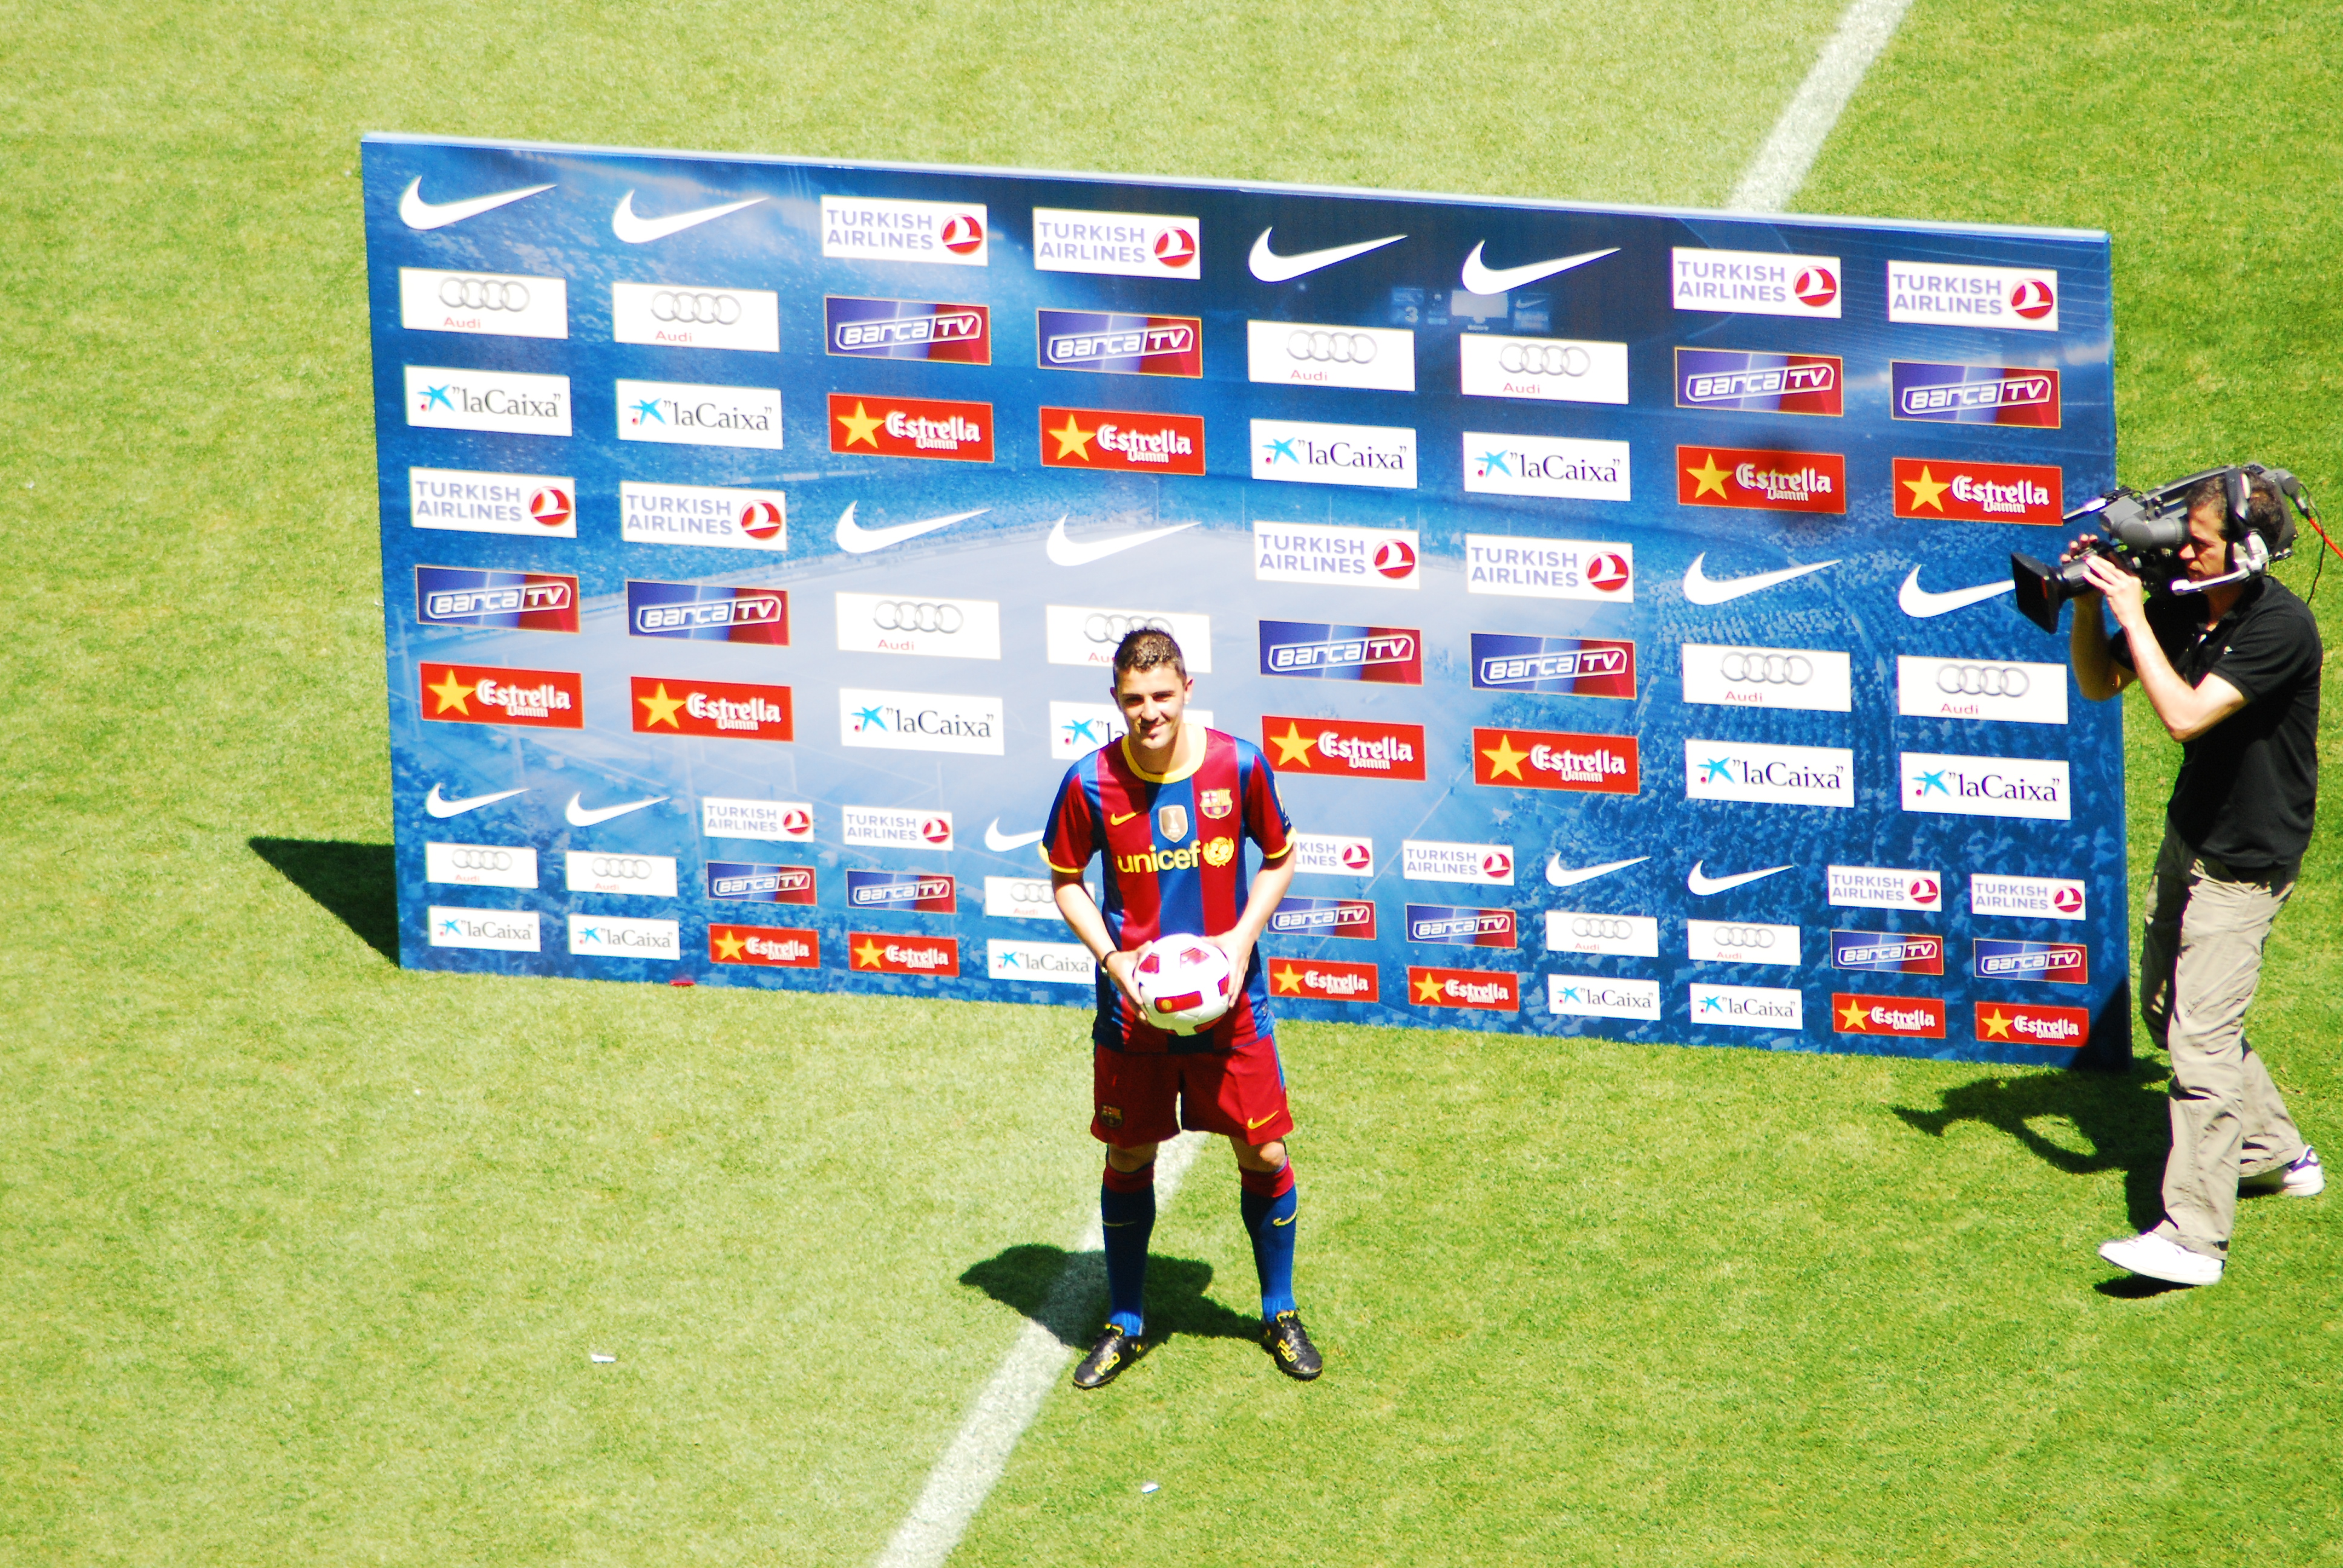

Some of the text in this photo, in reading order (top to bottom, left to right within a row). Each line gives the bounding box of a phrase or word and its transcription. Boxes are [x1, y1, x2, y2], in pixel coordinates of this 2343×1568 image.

[827, 209, 932, 230] TURKISH
[827, 229, 933, 250] AIRLINES
[1039, 222, 1145, 244] TURKISH
[1039, 242, 1145, 263] AIRLINES
[1677, 261, 1785, 283] TURKISH
[1677, 281, 1786, 301] AIRLINES
[1893, 274, 2001, 296] TURKISH
[1893, 294, 2002, 314] AIRLINES
[444, 317, 480, 329] Audi
[655, 331, 692, 342] Audi
[1289, 370, 1327, 382] Audi
[1502, 383, 1540, 394] Audi
[884, 411, 981, 442] Estrella
[1095, 423, 1192, 455] Estrella
[1734, 463, 1833, 494] Estrella
[415, 481, 521, 503] TURKISH
[1950, 475, 2050, 505] Estrella
[416, 501, 522, 521] AIRLINES
[626, 494, 732, 516] TURKISH
[627, 514, 733, 535] AIRLINES
[1259, 534, 1365, 555] TURKISH
[1259, 554, 1366, 574] AIRLINES
[1471, 547, 1578, 569] TURKISH
[1472, 567, 1579, 587] AIRLINES
[877, 639, 914, 651] Audi
[1088, 652, 1115, 664] Au
[475, 679, 571, 710] Estrella
[1724, 691, 1762, 702] Audi
[685, 693, 781, 723] Estrella
[1940, 704, 1978, 714] Audi
[1317, 731, 1414, 762] Estrella
[1529, 745, 1627, 775] Estrella
[707, 805, 777, 820] TURKISH
[847, 814, 917, 828] TURKISH
[707, 818, 778, 832] AIRLINES
[847, 827, 917, 840] AIRLINES
[1117, 839, 1201, 874] unicef
[1294, 841, 1337, 854] KISH
[1406, 849, 1477, 863] TURKISH
[1407, 861, 1477, 875] AIRLINES
[1832, 875, 1904, 889] TURKISH
[1975, 883, 2048, 897] TURKISH
[1832, 887, 1904, 900] AIRLINES
[1976, 896, 2048, 909] AIRLINES
[746, 936, 810, 956] Estrella
[885, 944, 949, 965] Estrella
[1304, 970, 1369, 990] Estrella
[1444, 979, 1509, 999] Estrella
[1870, 1006, 1936, 1027] Estrella
[2013, 1014, 2080, 1035] Estrella
